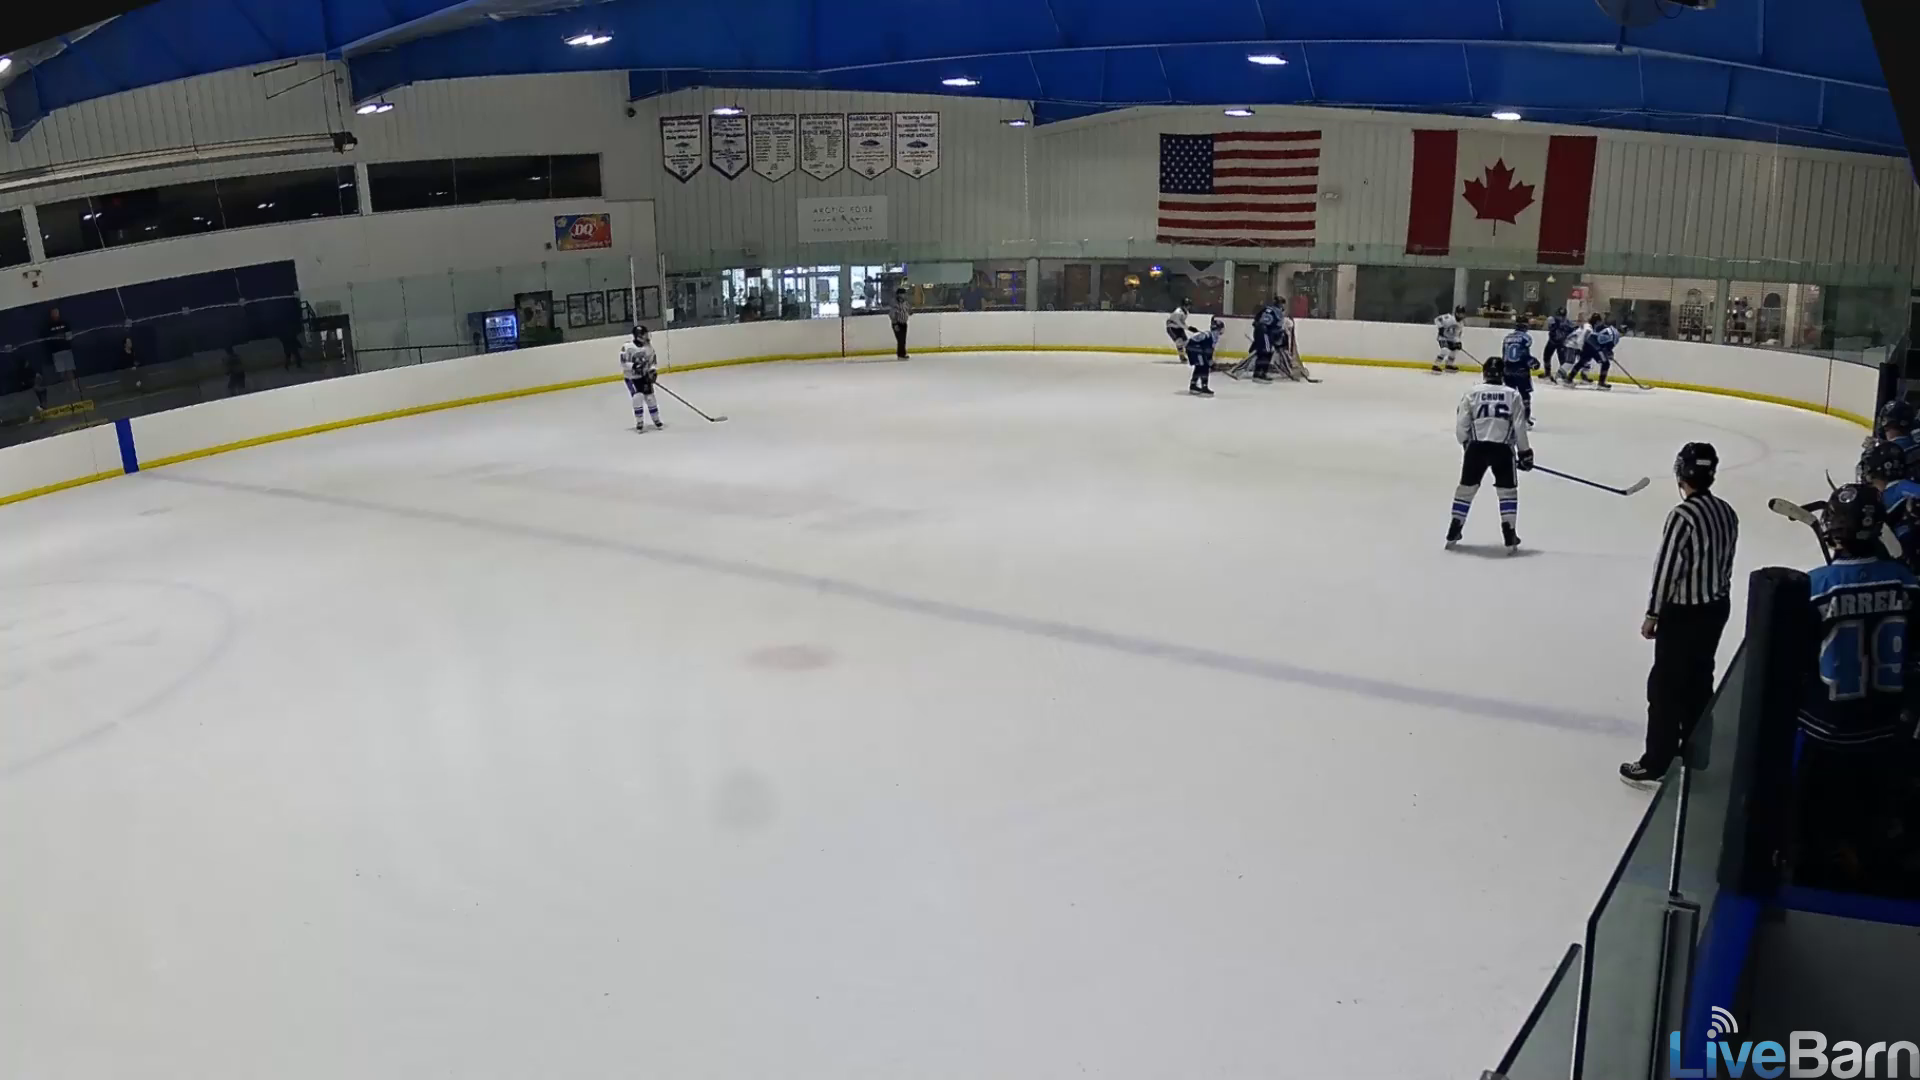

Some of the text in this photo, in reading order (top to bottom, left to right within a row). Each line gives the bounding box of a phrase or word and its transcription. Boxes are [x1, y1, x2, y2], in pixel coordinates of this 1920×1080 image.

[812, 206, 845, 214] ARCTIC
[574, 223, 594, 236] DQ
[1481, 392, 1505, 401] CRUM
[1817, 589, 1912, 622] ARREL
[1819, 616, 1907, 701] 49
